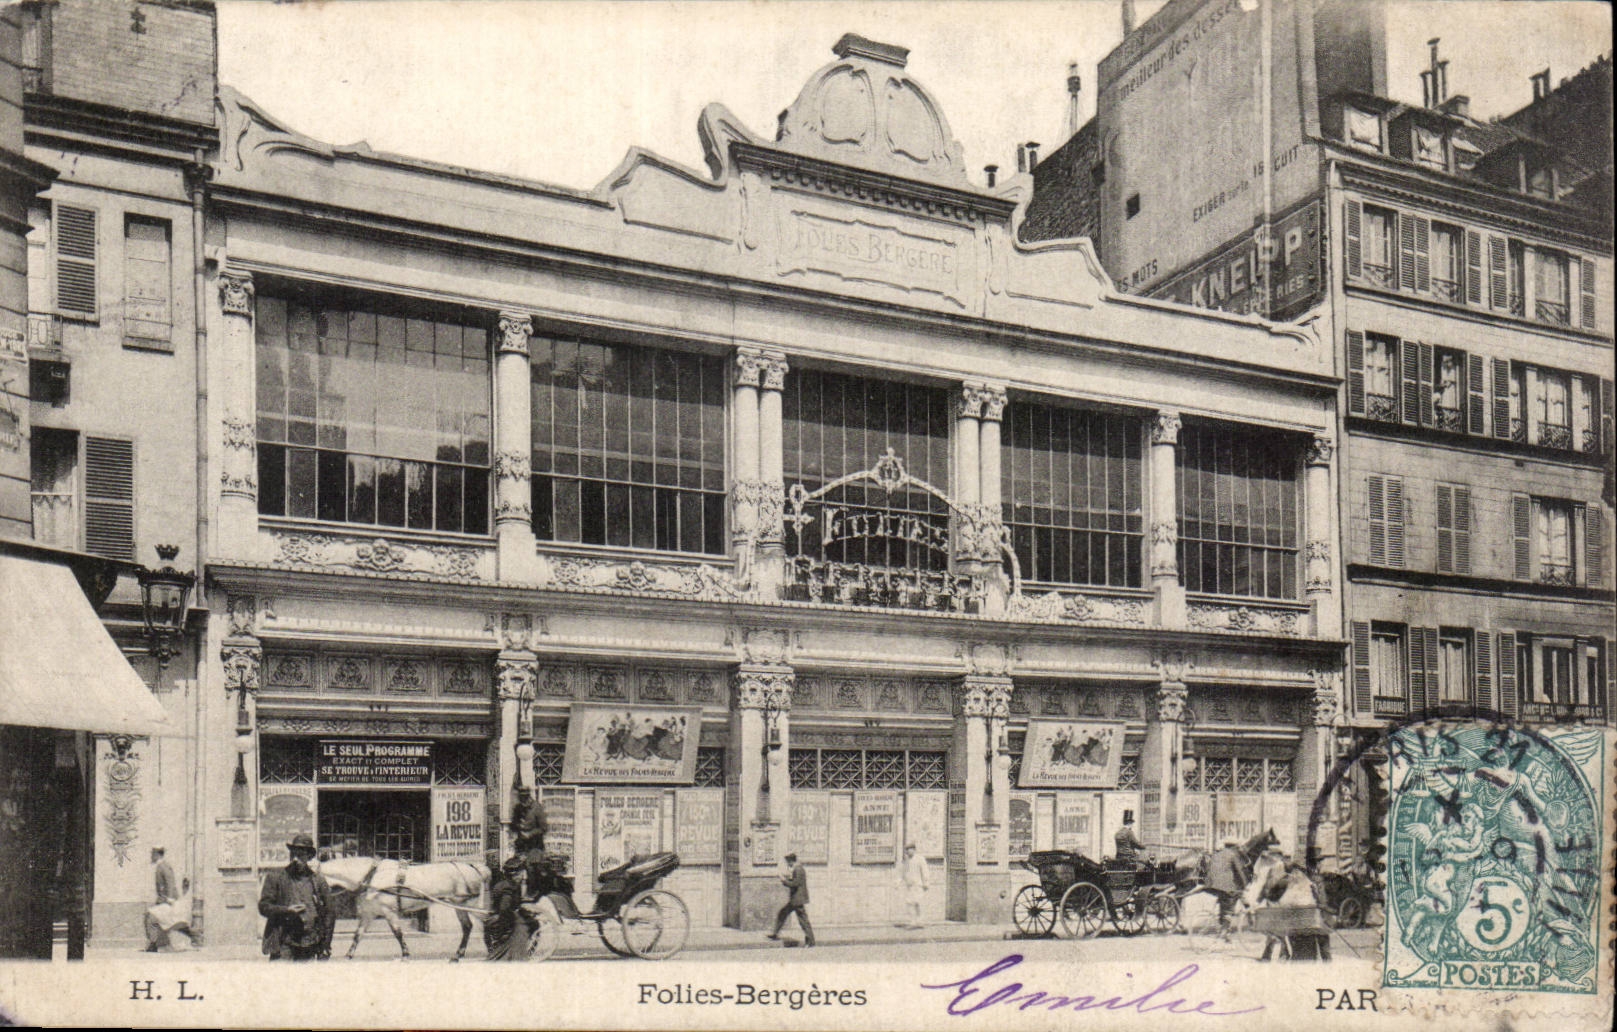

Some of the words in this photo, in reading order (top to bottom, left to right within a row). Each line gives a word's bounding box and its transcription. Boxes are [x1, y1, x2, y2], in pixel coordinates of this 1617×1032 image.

[1168, 33, 1190, 61] des
[1131, 258, 1158, 288] MOTS
[323, 745, 336, 756] LE
[339, 744, 365, 756] SEUL
[366, 744, 431, 757] PROGRAMME
[321, 766, 334, 776] SE
[335, 766, 371, 775] TROUVE
[332, 757, 363, 765] EXACT
[374, 757, 419, 766] COMPLET
[446, 800, 472, 822] 198
[863, 804, 890, 813] ANNE
[436, 825, 449, 840] LA
[450, 824, 481, 840] REVUE
[1219, 820, 1257, 840] REVUE
[920, 954, 1266, 1016] Emilie
[1444, 963, 1536, 987] POSTES
